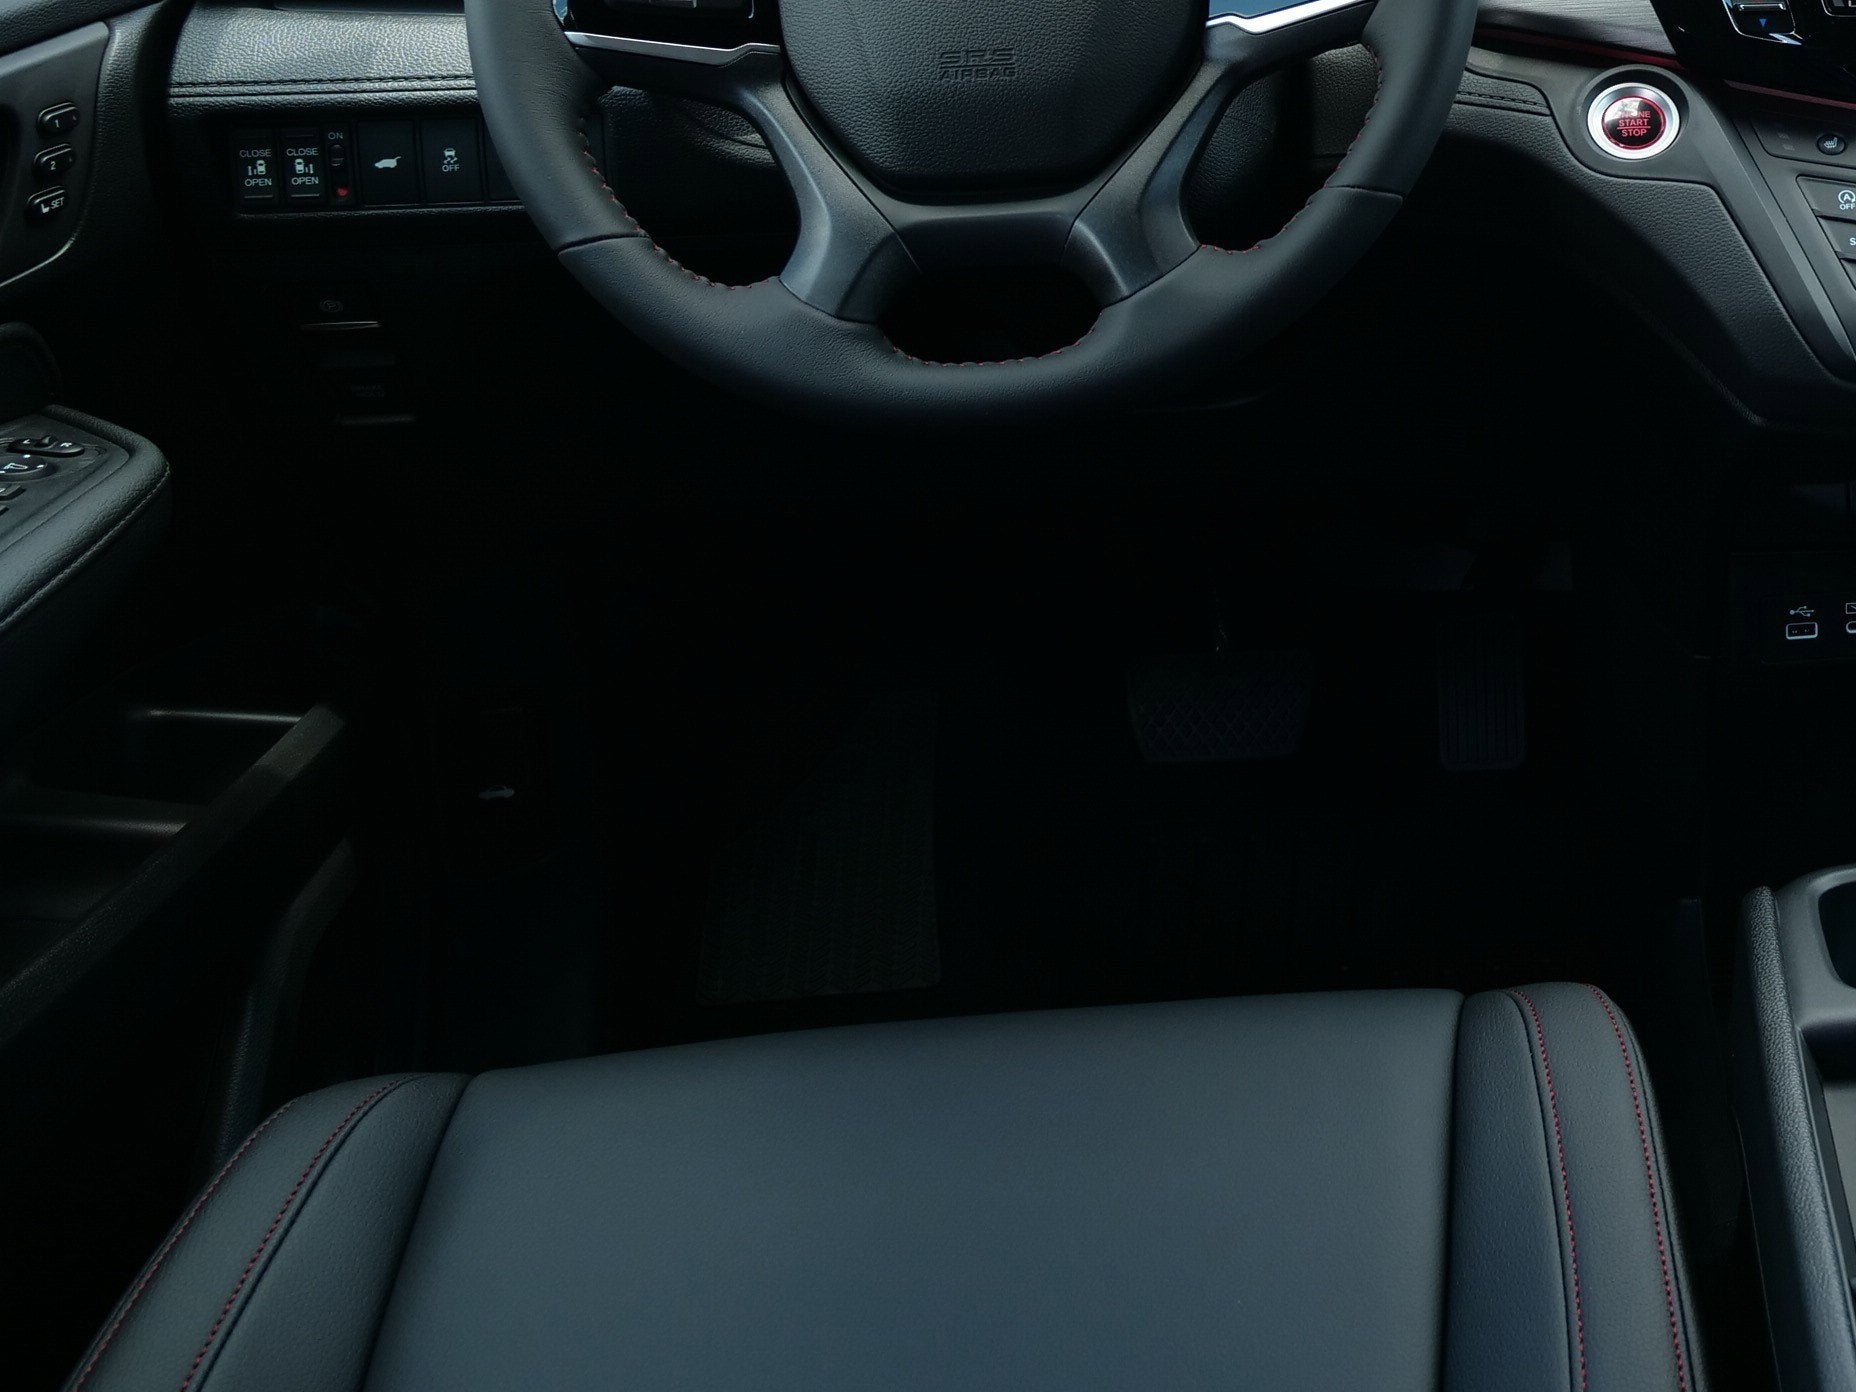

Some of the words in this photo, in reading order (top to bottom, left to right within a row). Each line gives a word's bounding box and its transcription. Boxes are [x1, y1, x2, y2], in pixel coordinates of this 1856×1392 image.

[940, 48, 1015, 65] SRS
[1619, 118, 1649, 127] START
[328, 132, 344, 140] ON
[1622, 128, 1647, 137] STOP
[239, 149, 271, 157] CLOSE
[286, 148, 319, 156] CLOSE
[50, 161, 56, 170] 2
[442, 164, 460, 172] OFF
[244, 178, 272, 187] OPEN
[291, 177, 319, 186] OPEN
[51, 197, 64, 209] SET
